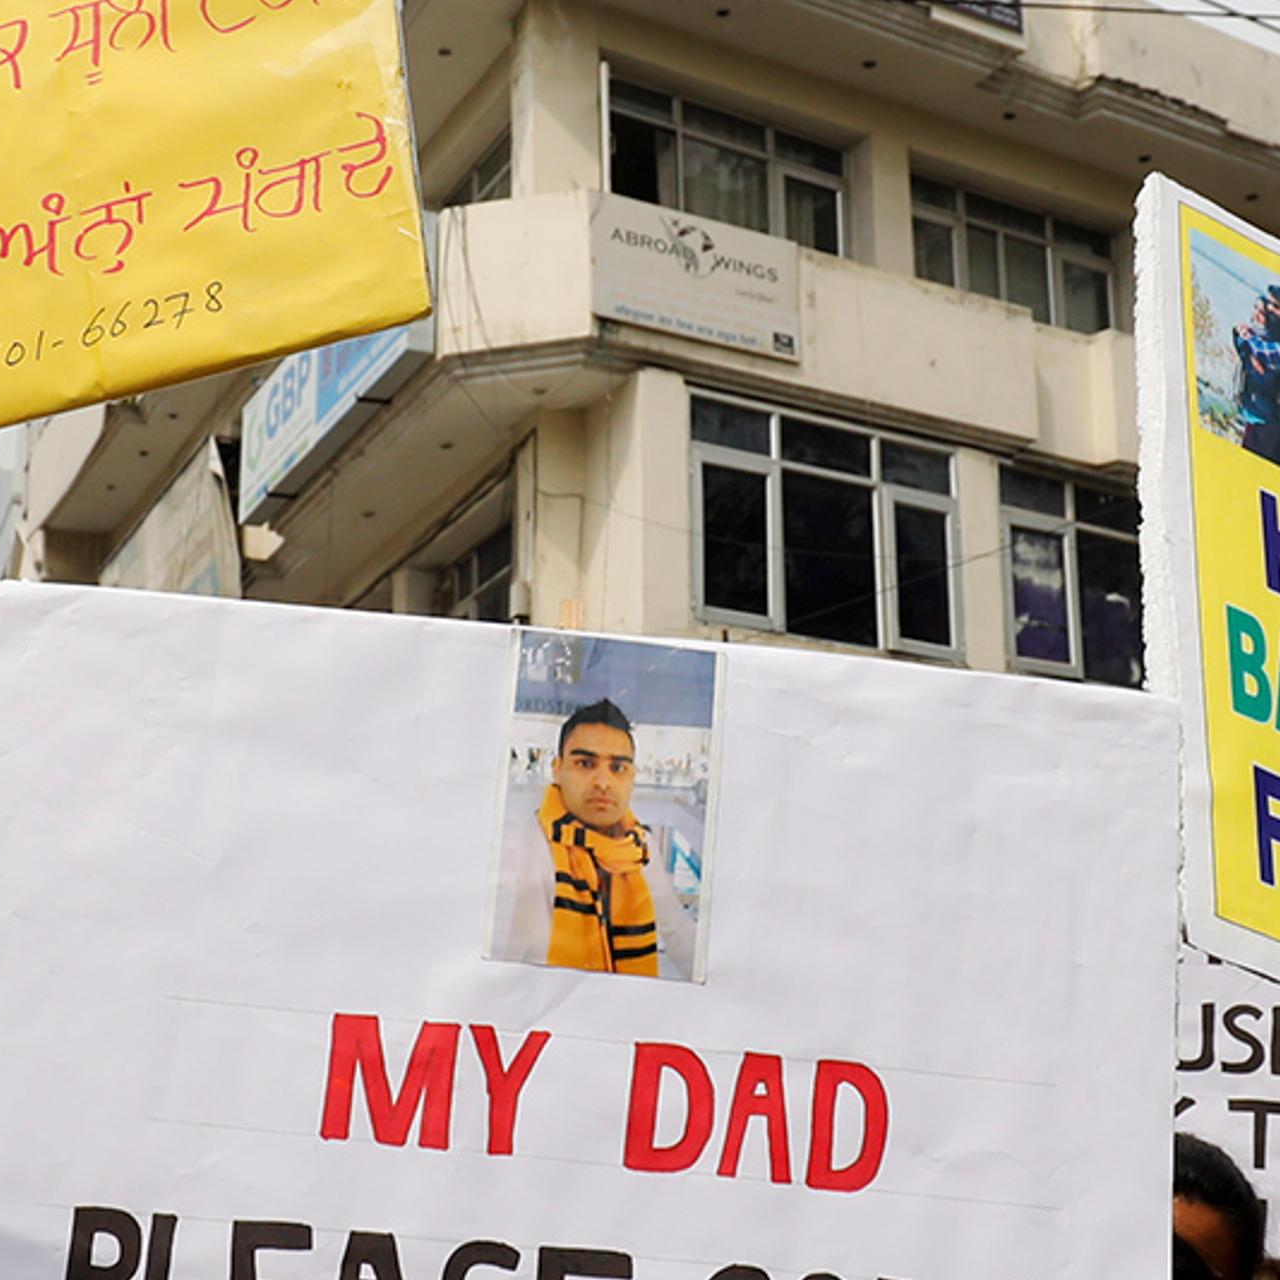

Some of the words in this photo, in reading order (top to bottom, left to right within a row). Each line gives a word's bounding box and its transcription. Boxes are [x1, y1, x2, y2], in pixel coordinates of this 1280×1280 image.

[611, 226, 698, 266] ABROAD
[712, 254, 779, 284] WINGS
[320, 1012, 551, 1156] MY
[623, 1041, 891, 1192] DAD
